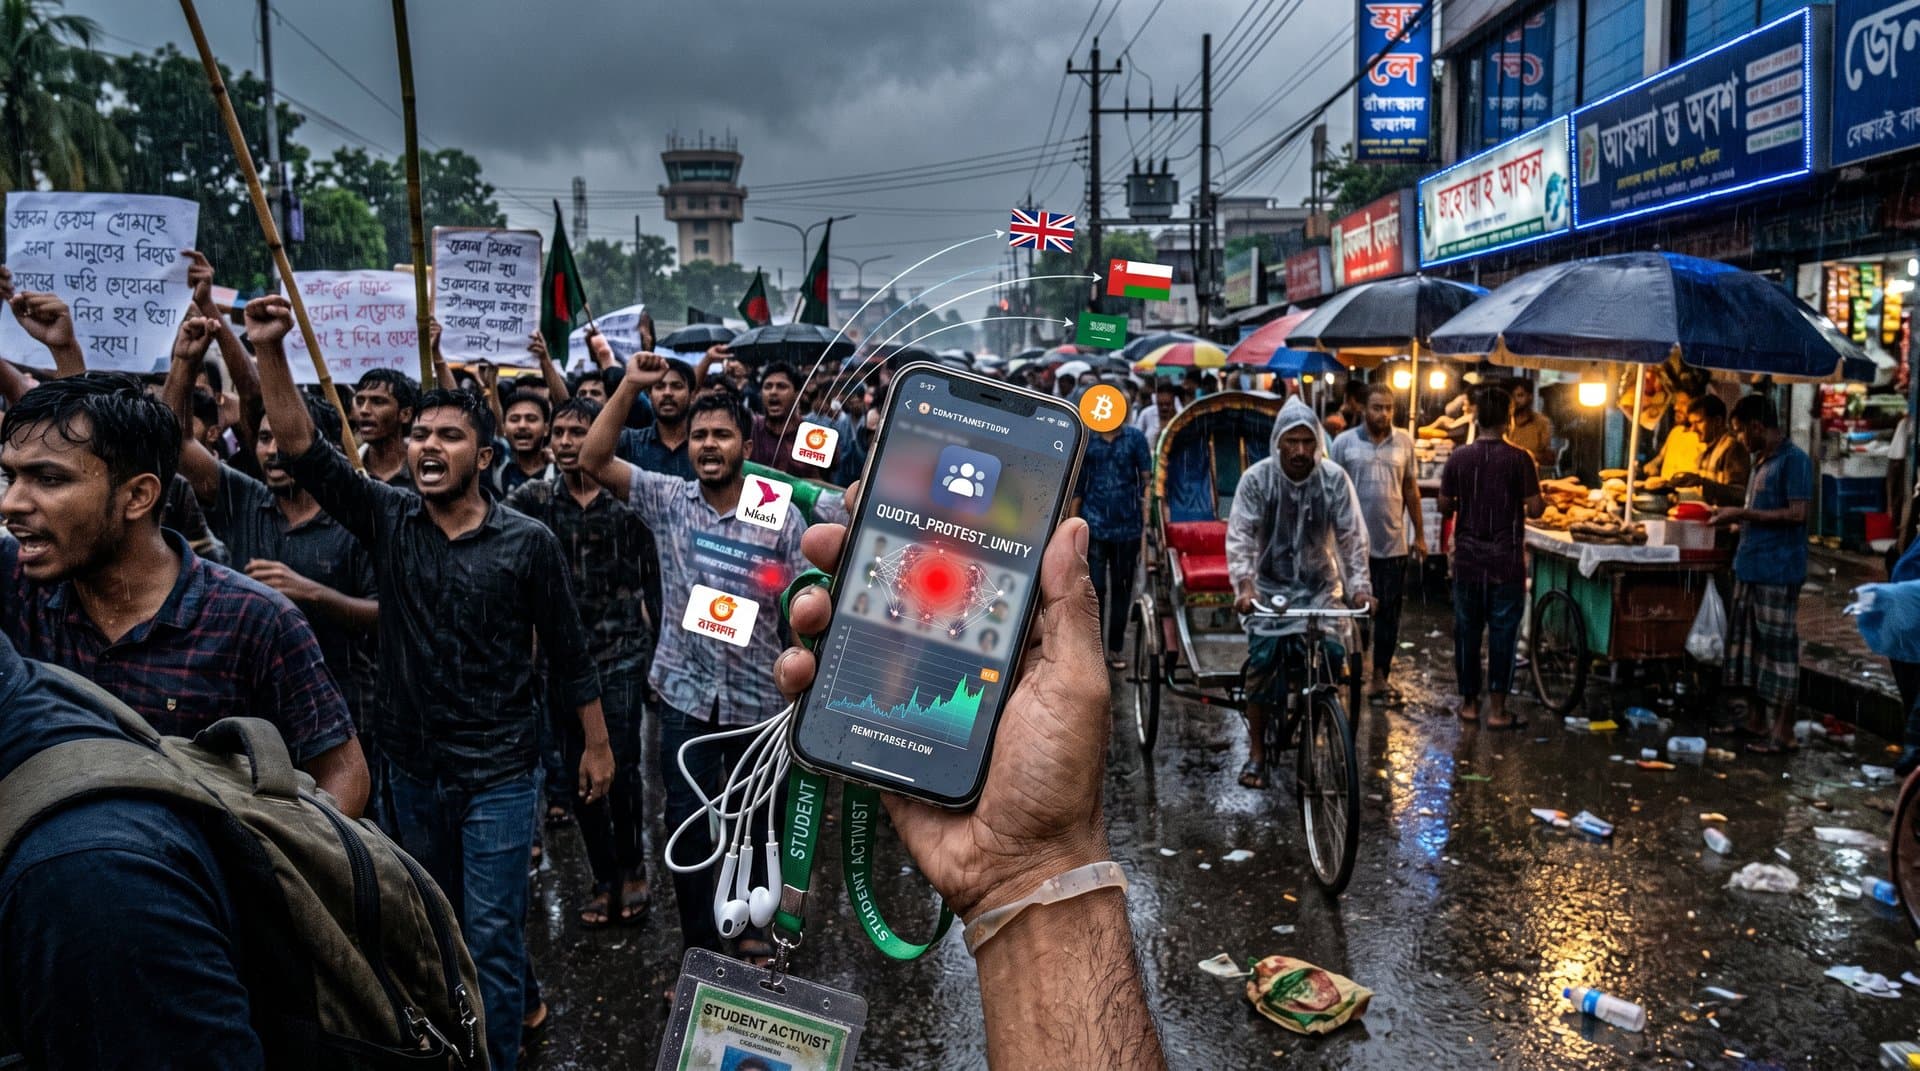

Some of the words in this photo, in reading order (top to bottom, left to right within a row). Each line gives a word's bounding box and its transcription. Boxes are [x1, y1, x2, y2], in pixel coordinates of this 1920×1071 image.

[876, 503, 1032, 558] QUOTA_PROTEST_UNITY
[907, 741, 934, 756] FLOW
[790, 779, 817, 860] STUDENT
[851, 800, 869, 865] ACTIVIST
[852, 872, 889, 942] STUDENT
[703, 1003, 768, 1032] STUDENT
[768, 1023, 831, 1051] ACTIVIST
